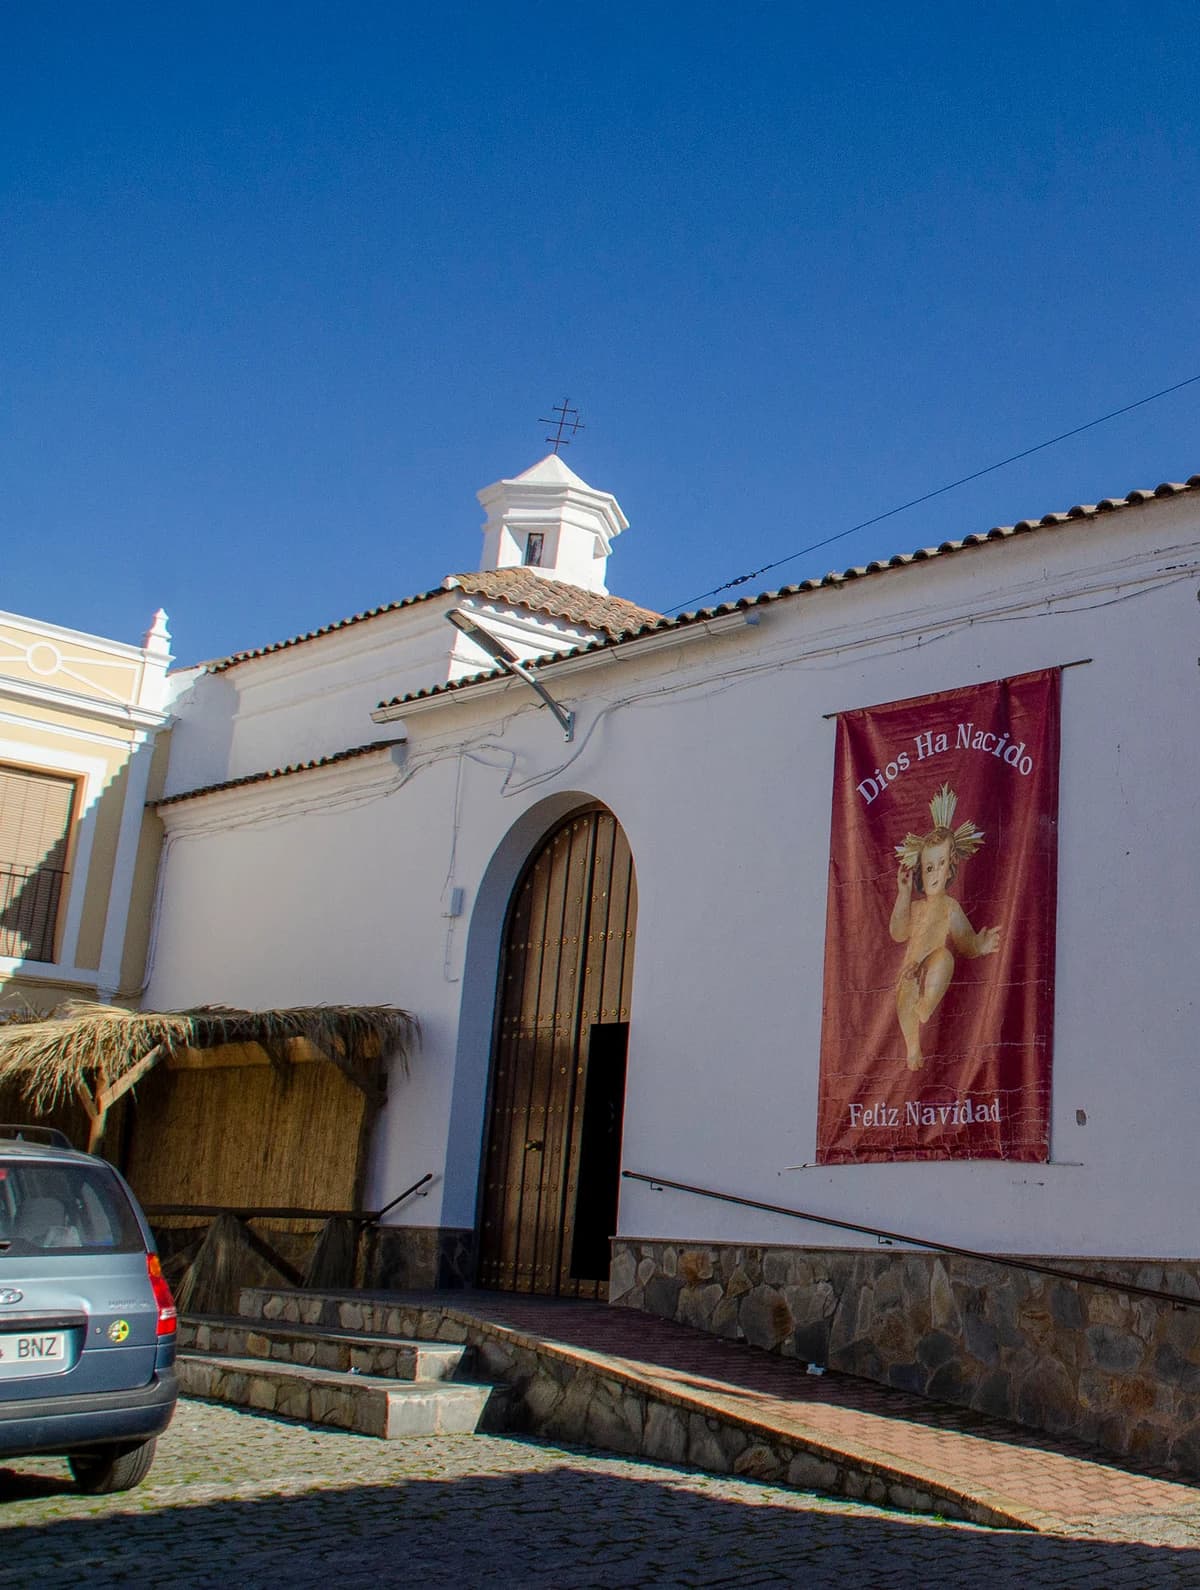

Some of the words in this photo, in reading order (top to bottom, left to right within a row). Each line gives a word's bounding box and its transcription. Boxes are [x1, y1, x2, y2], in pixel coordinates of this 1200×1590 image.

[856, 751, 911, 805] Dios
[914, 730, 950, 761] Ha
[955, 722, 1034, 776] Nacido
[848, 1101, 899, 1128] Feliz
[905, 1098, 1002, 1126] Navidad
[18, 1336, 57, 1358] BNZ
